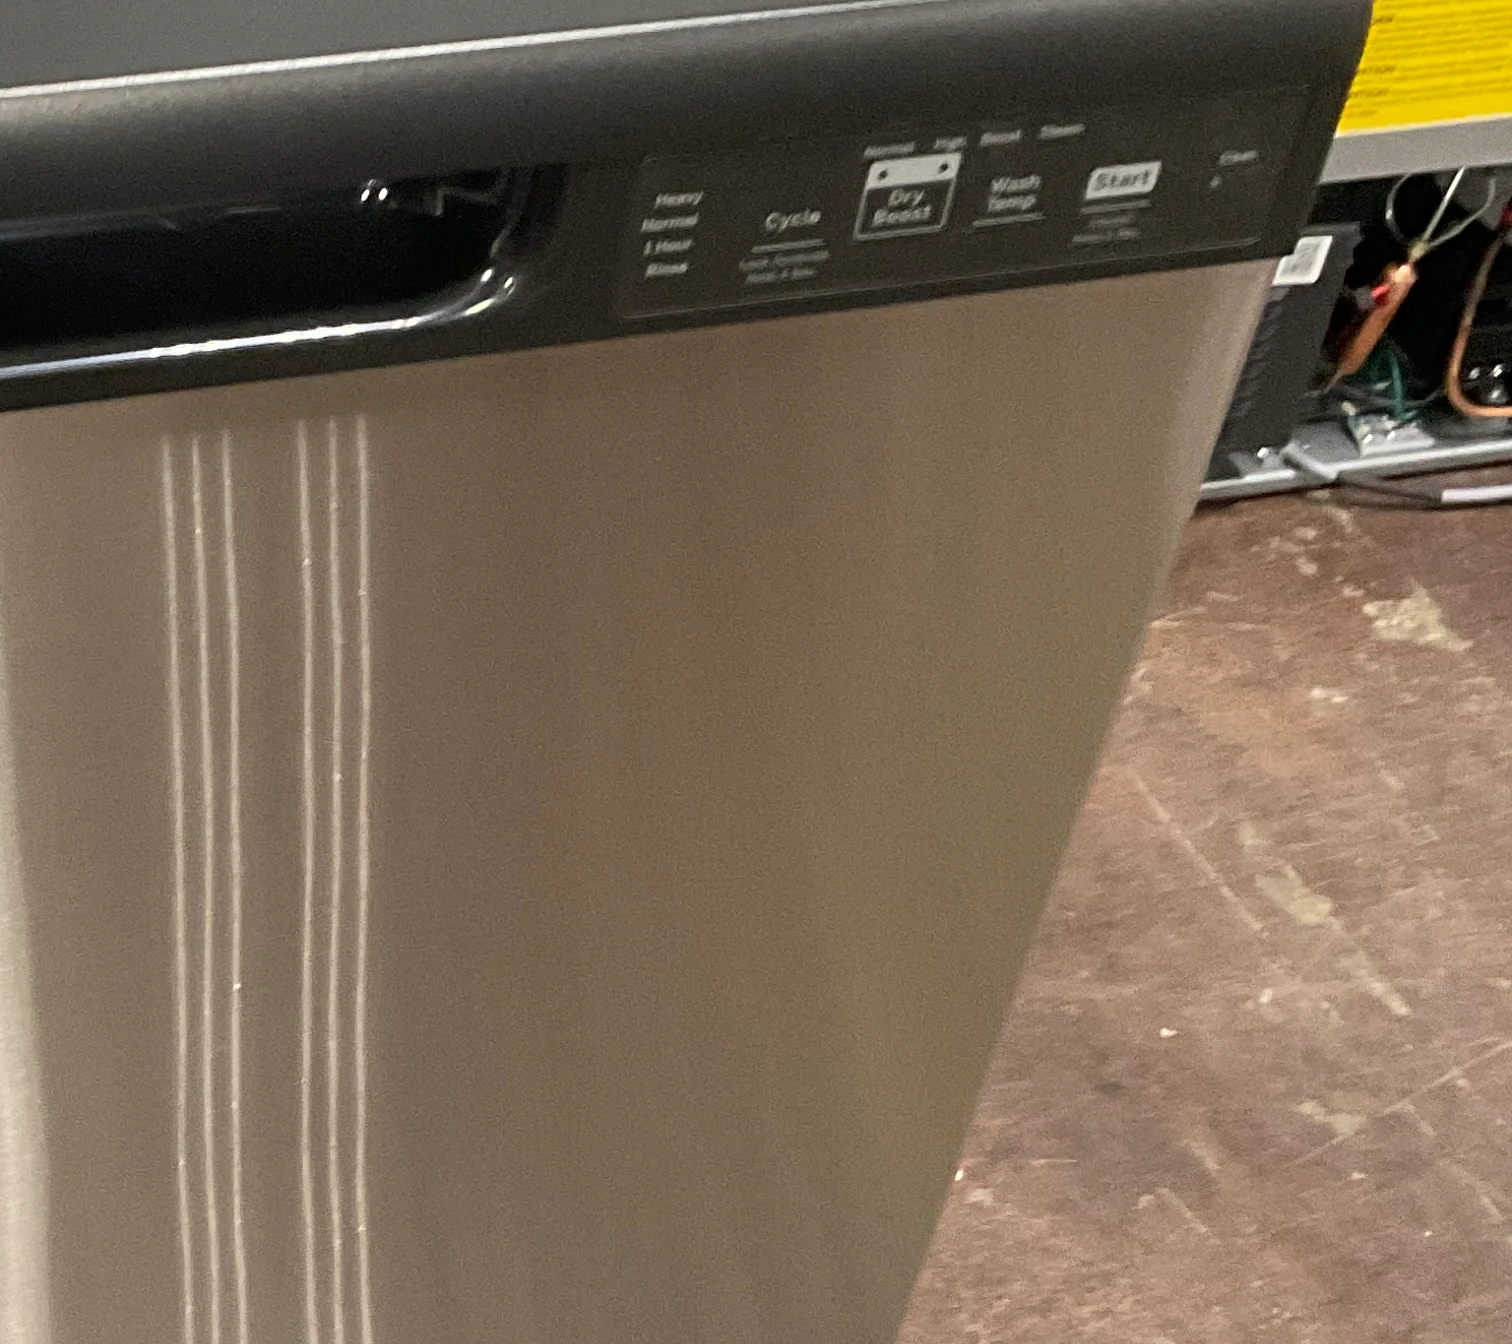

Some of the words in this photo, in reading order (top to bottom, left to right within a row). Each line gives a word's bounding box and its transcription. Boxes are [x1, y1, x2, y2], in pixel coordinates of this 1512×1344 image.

[1094, 169, 1152, 192] Start
[888, 189, 925, 207] Dry
[764, 208, 822, 233] Cycle
